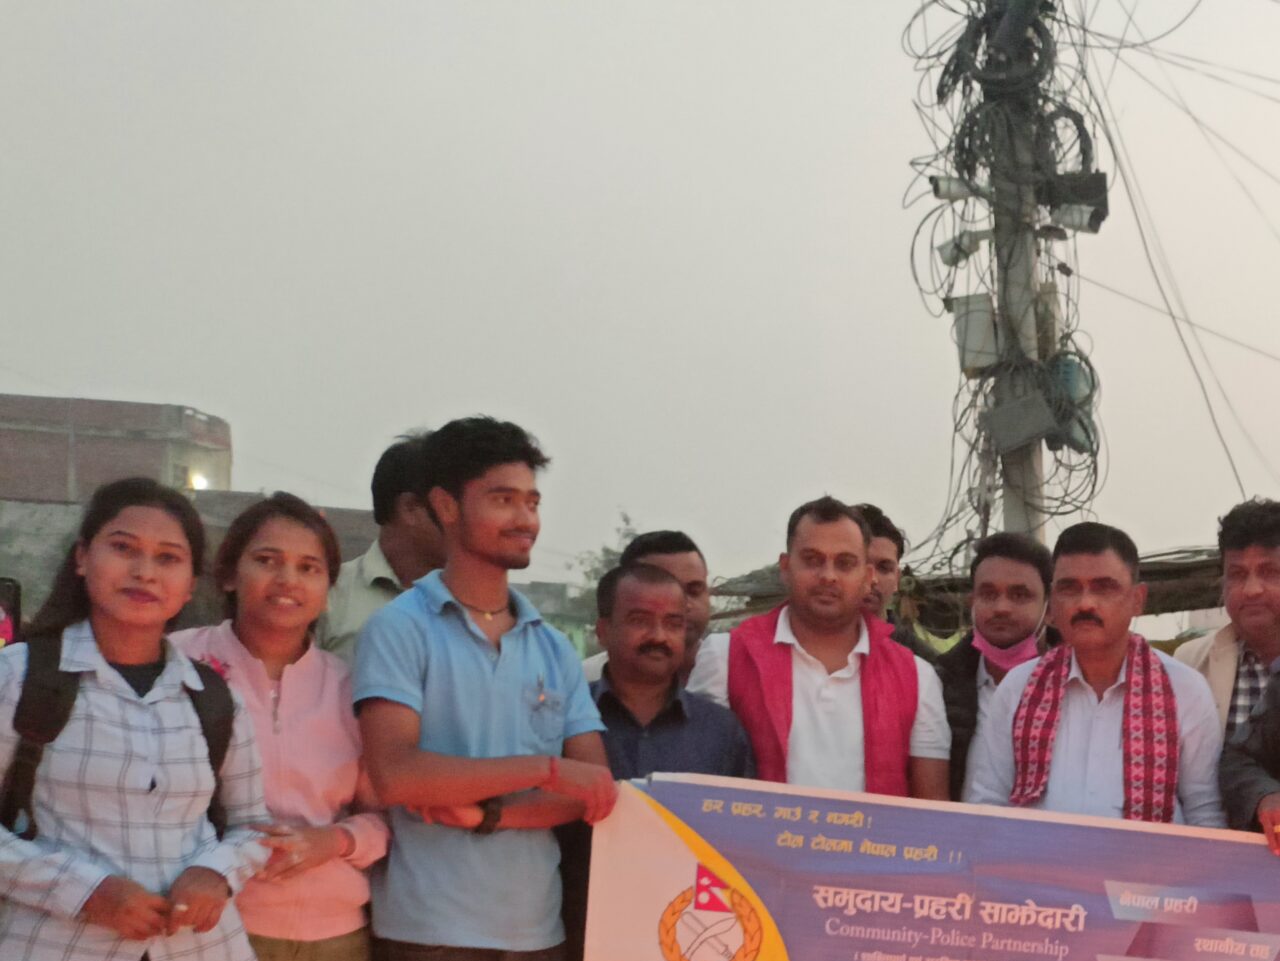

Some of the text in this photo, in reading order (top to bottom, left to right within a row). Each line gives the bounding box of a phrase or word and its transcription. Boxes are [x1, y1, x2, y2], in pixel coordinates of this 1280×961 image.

[808, 811, 822, 825] र
[812, 884, 1088, 933] समुदाय-प्रहरी साझेदारी
[1163, 895, 1199, 915] प्रहरी
[824, 917, 1070, 961] Community-Police Partnership
[1194, 936, 1271, 960] स्थानीय तह
